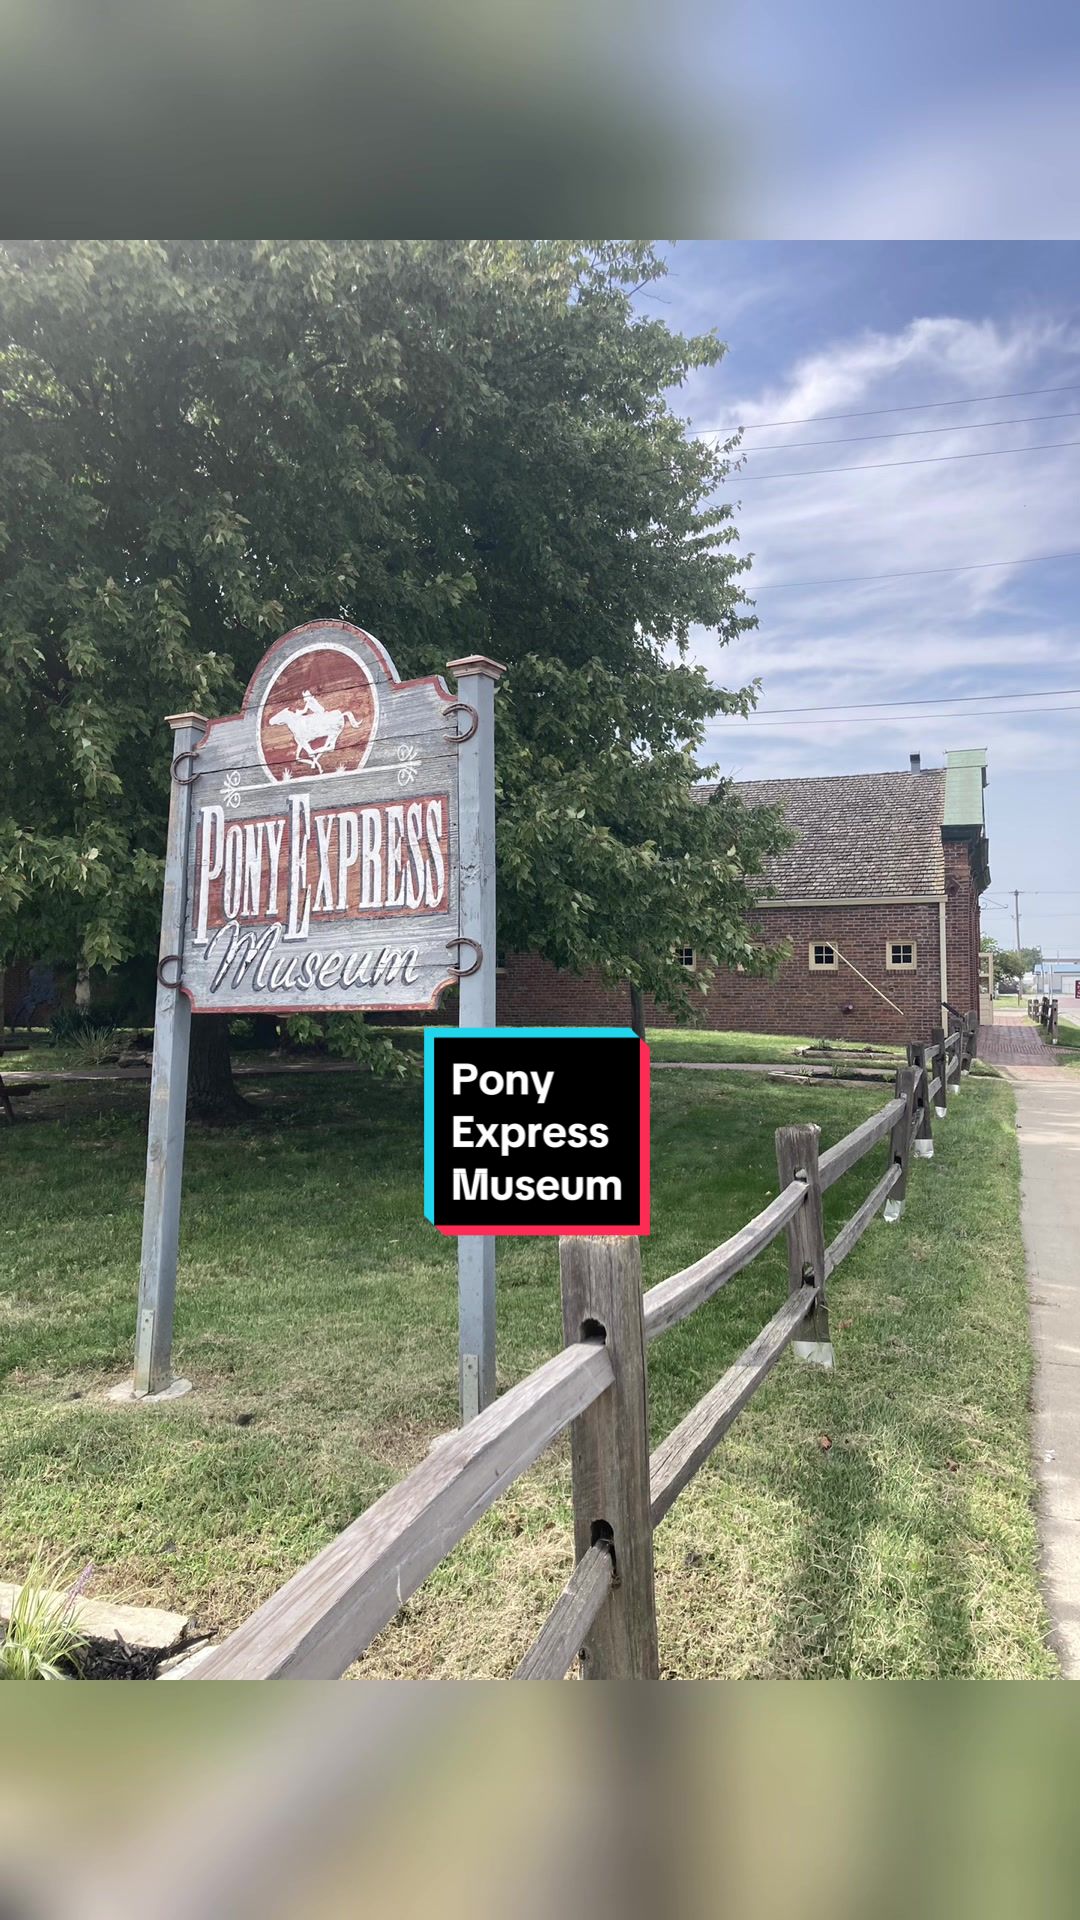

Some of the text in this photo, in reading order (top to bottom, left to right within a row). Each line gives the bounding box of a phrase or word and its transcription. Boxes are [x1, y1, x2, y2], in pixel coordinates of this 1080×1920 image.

[194, 793, 444, 944] PONY EXPRESS
[204, 920, 419, 992] Museum
